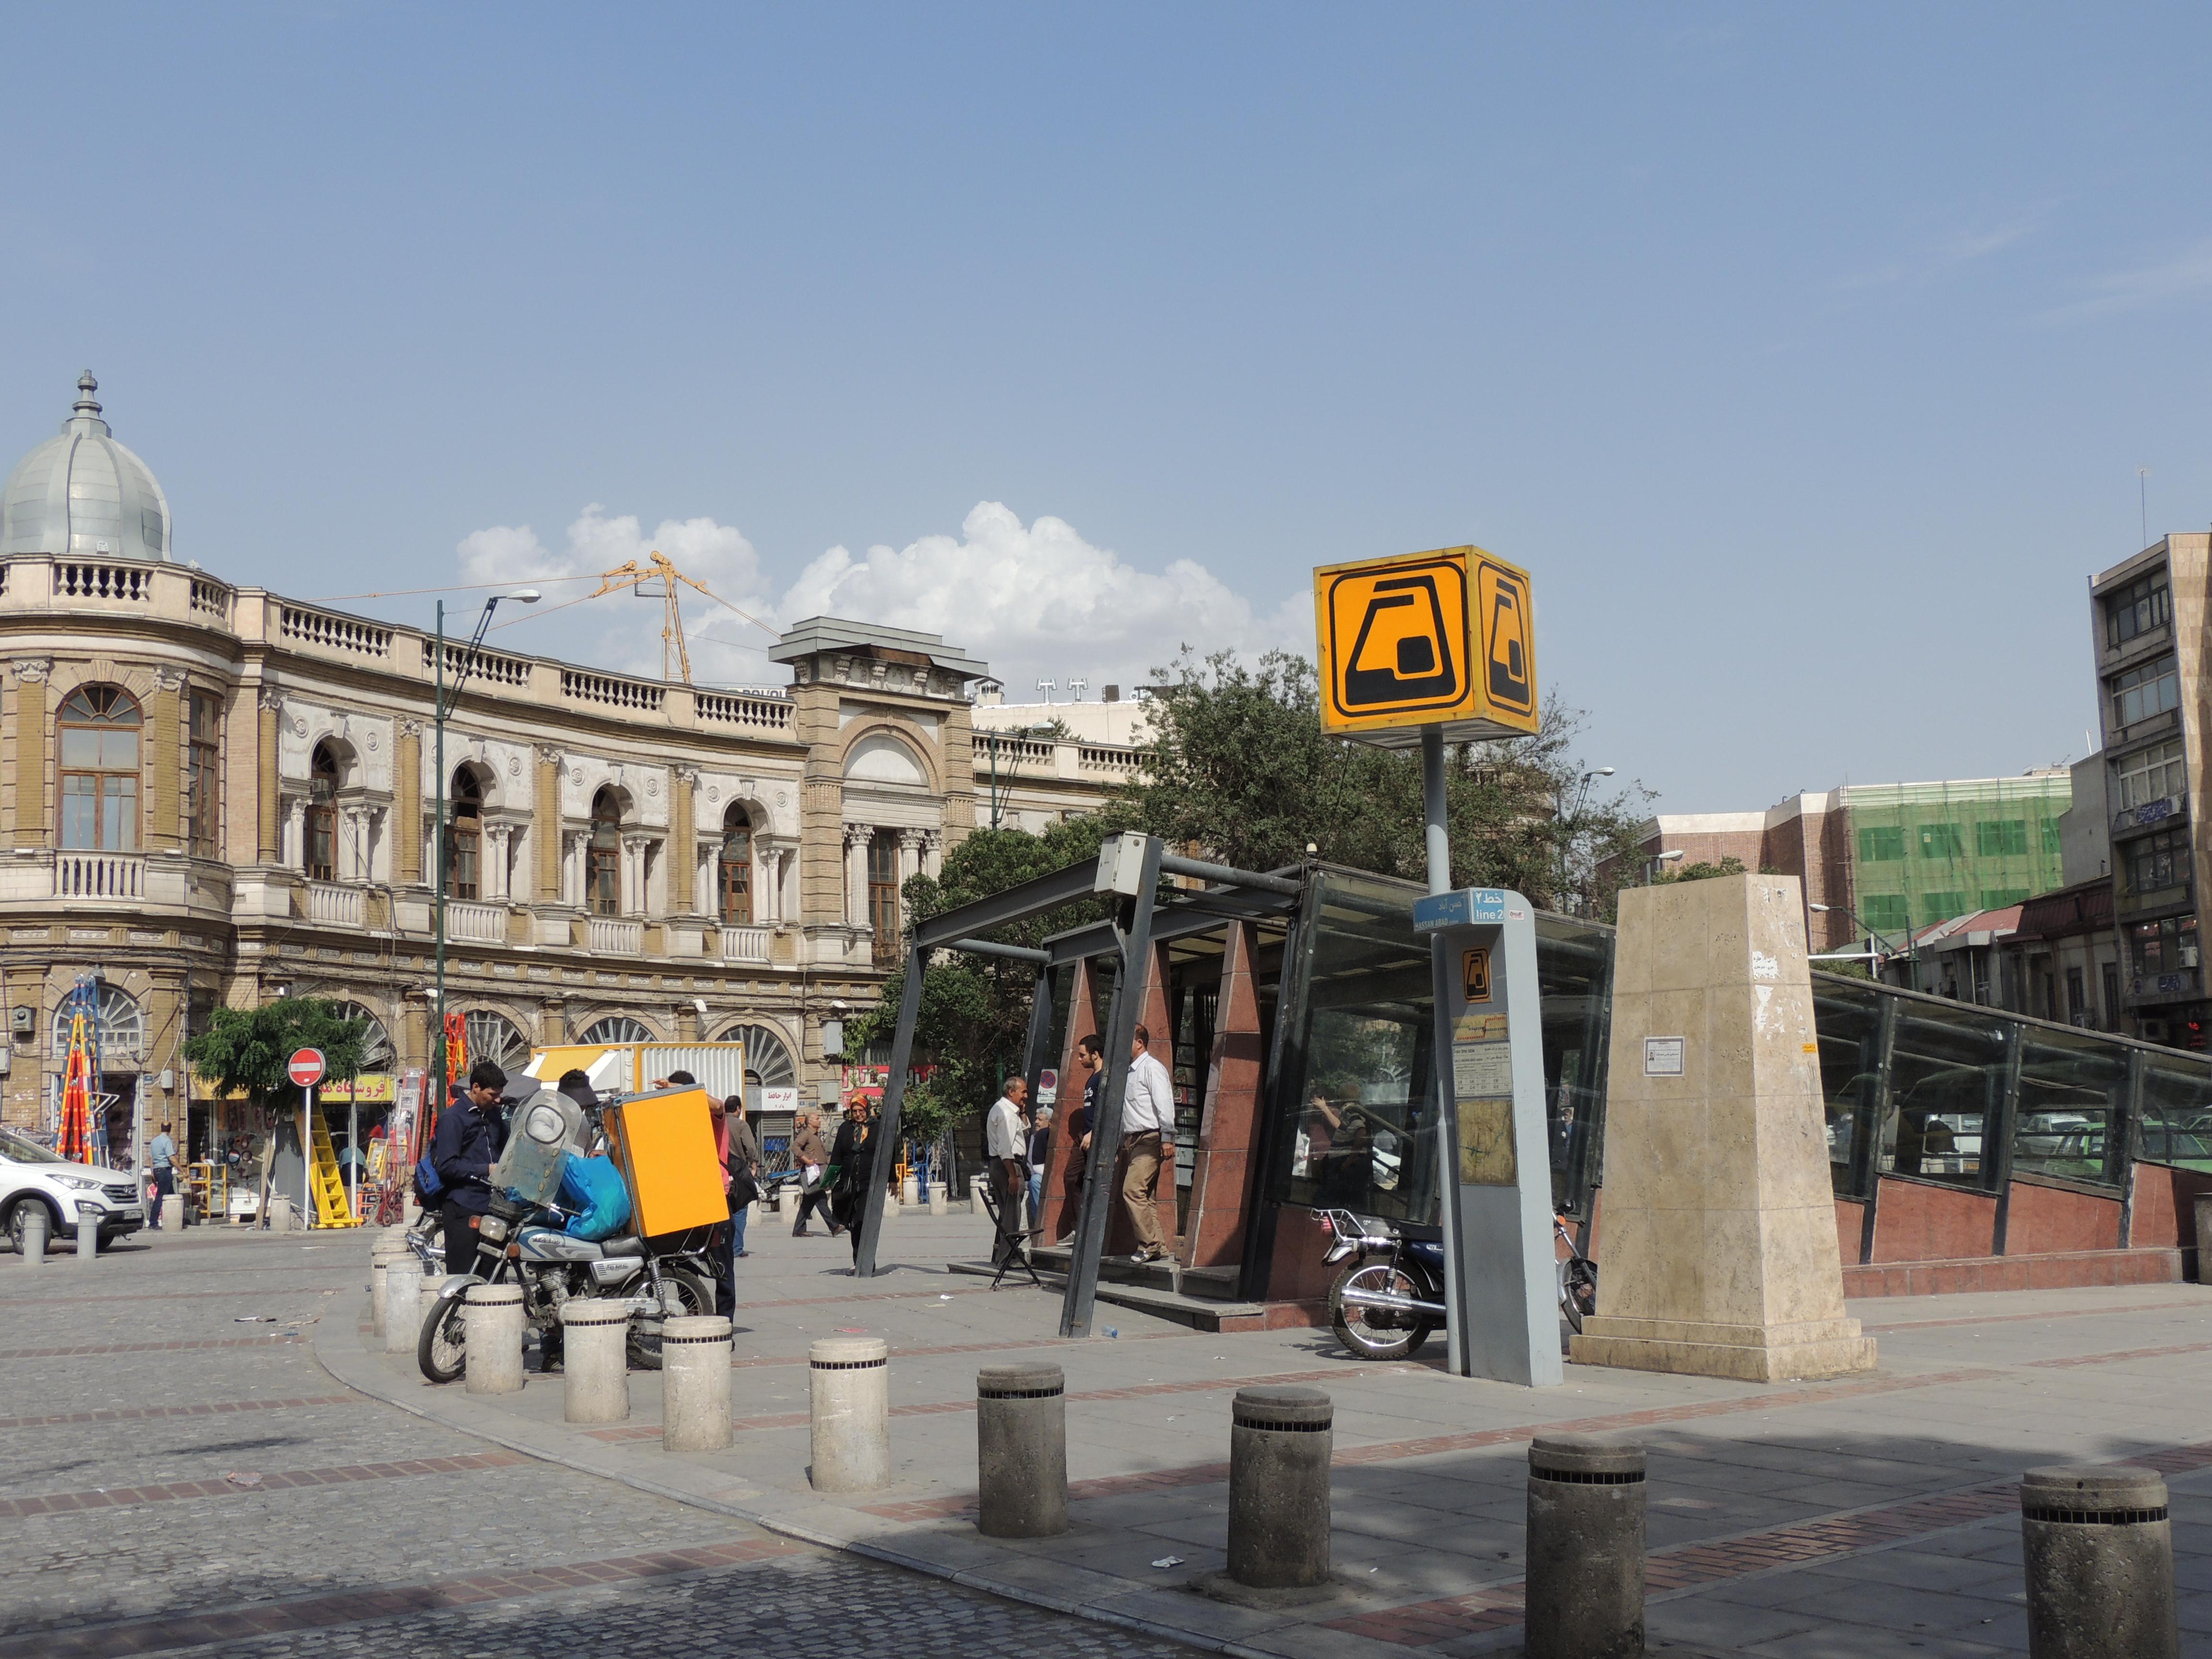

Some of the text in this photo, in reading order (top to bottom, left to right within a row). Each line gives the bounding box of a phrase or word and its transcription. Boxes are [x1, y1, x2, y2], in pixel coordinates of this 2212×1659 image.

[1475, 892, 1482, 904] ۲
[1483, 893, 1503, 903] خط
[1449, 901, 1462, 912] حسن
[1477, 910, 1495, 919] line
[1497, 910, 1503, 919] 2
[1415, 918, 1448, 929] HASSAN ABAD
[782, 1092, 792, 1101] ابزار
